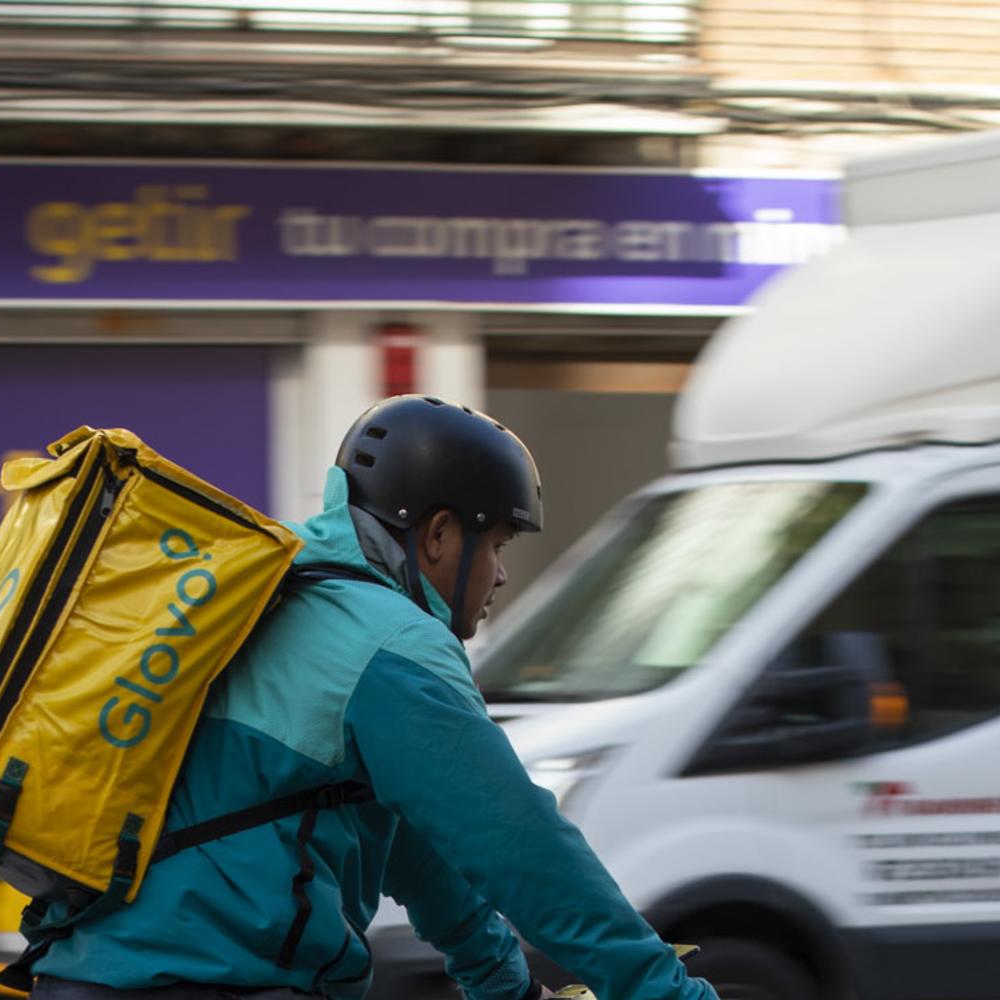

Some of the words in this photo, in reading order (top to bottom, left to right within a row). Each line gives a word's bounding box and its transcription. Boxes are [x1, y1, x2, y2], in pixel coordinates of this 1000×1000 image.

[27, 184, 250, 283] getir
[277, 207, 360, 256] tu
[366, 216, 607, 275] compra
[98, 567, 217, 748] Glovo
